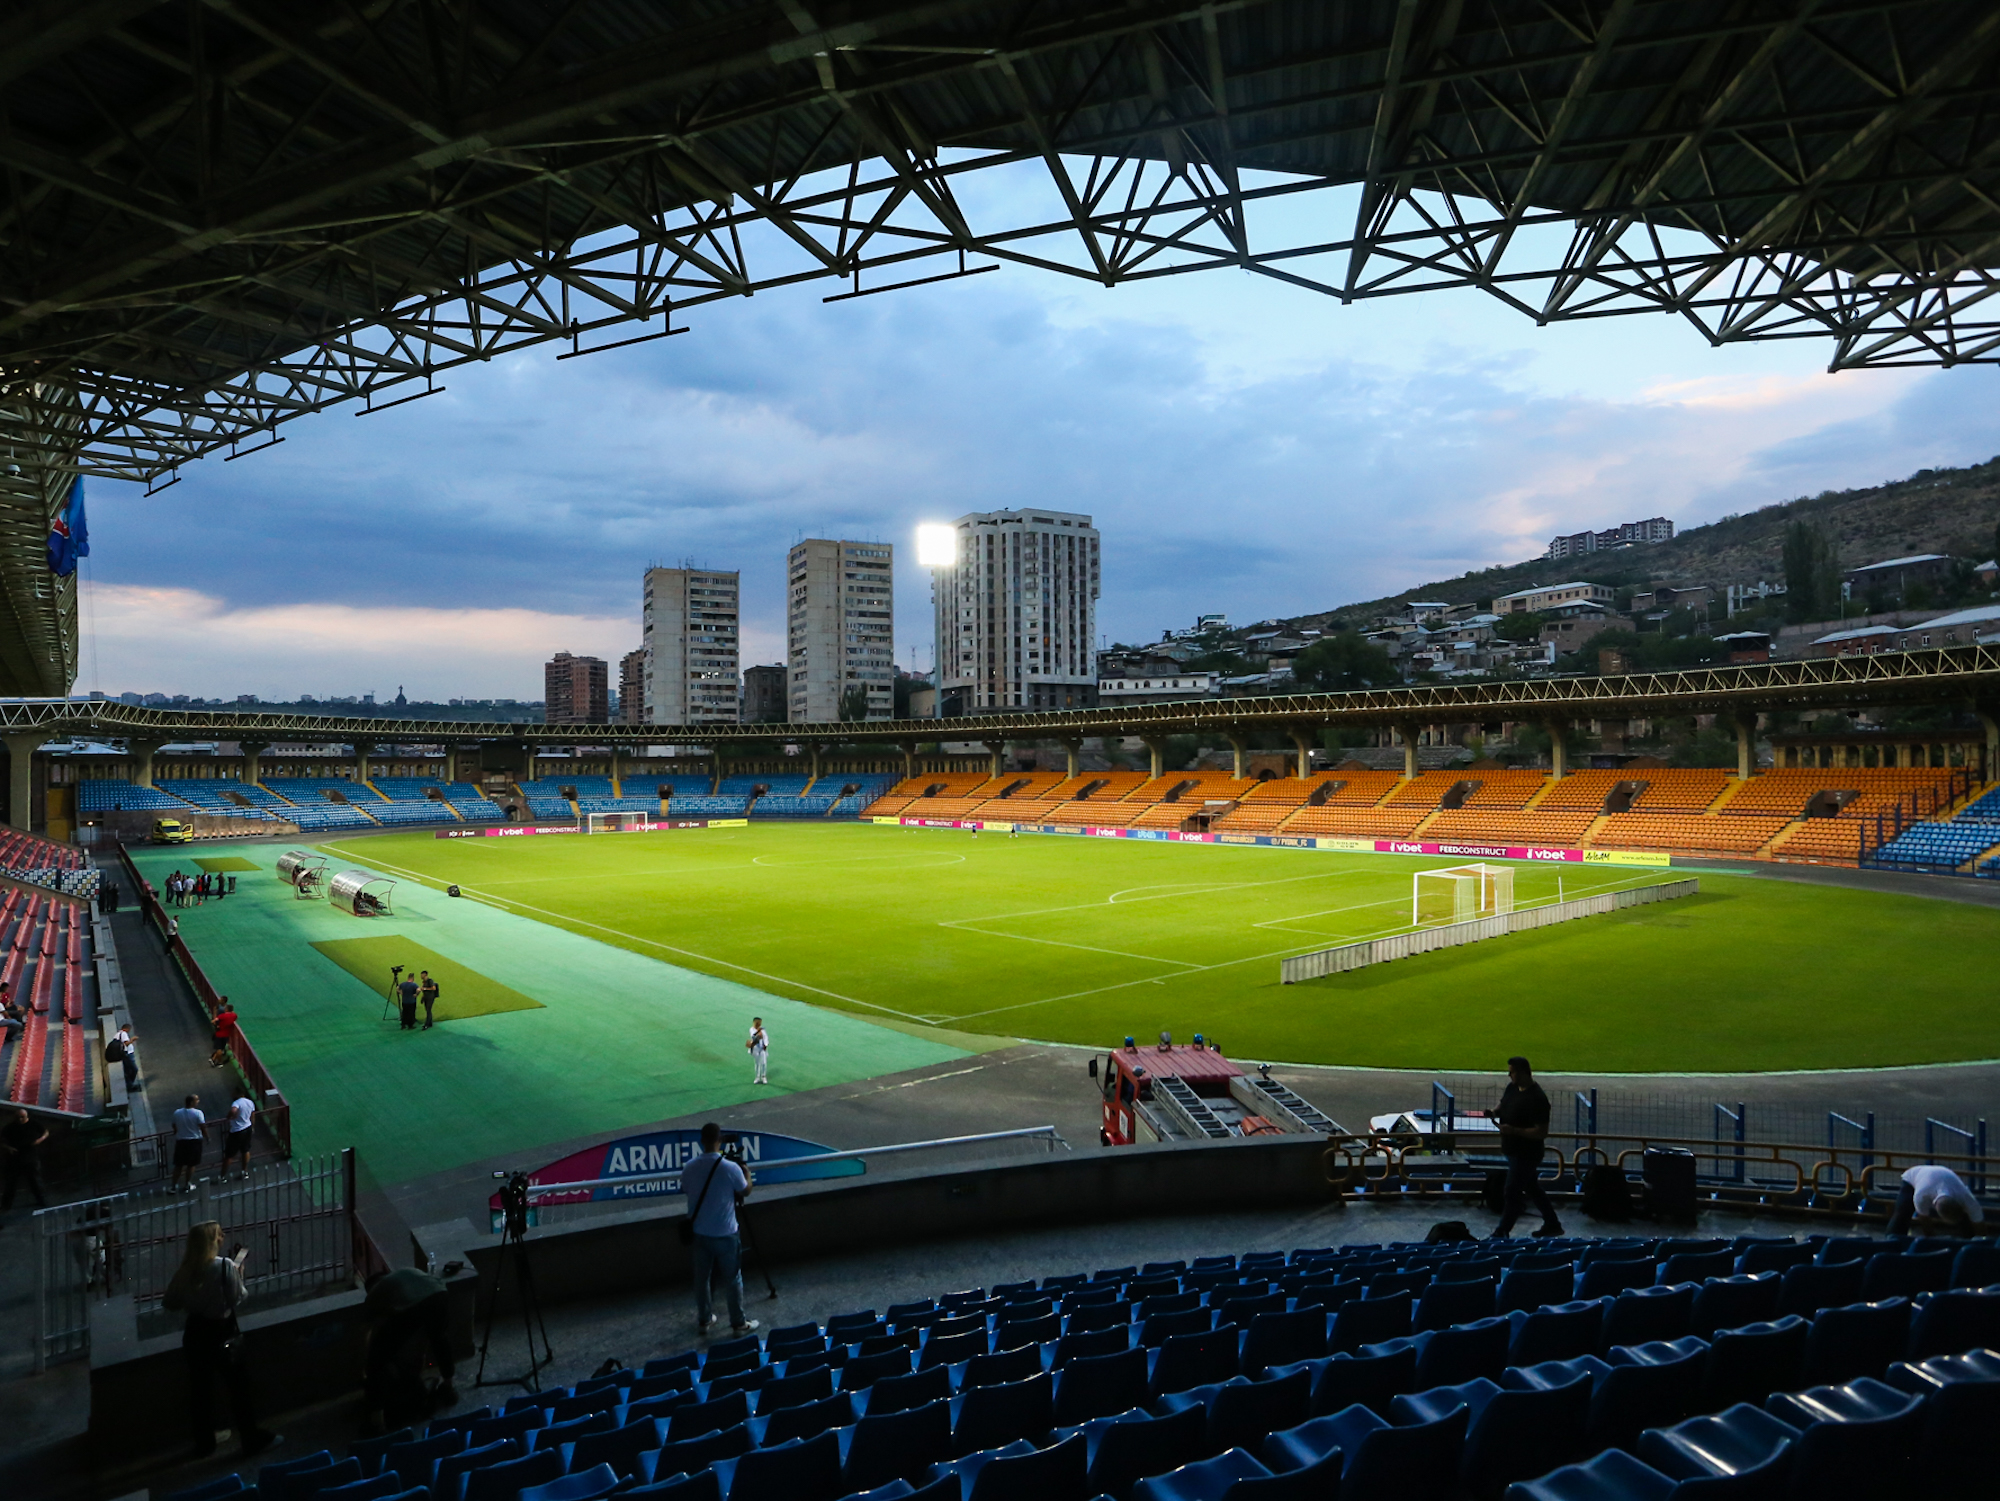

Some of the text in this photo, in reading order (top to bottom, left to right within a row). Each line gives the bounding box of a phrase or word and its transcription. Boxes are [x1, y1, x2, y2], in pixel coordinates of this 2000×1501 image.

[503, 828, 525, 836] vbet
[1100, 828, 1117, 837] vbet
[1184, 833, 1203, 842] vbet
[1396, 843, 1423, 853] vbet
[1439, 845, 1507, 856] FEEDCONSTRUCT
[1535, 849, 1566, 860] vbet
[608, 1136, 762, 1174] ARMENAN
[613, 1178, 683, 1196] PREMIE
